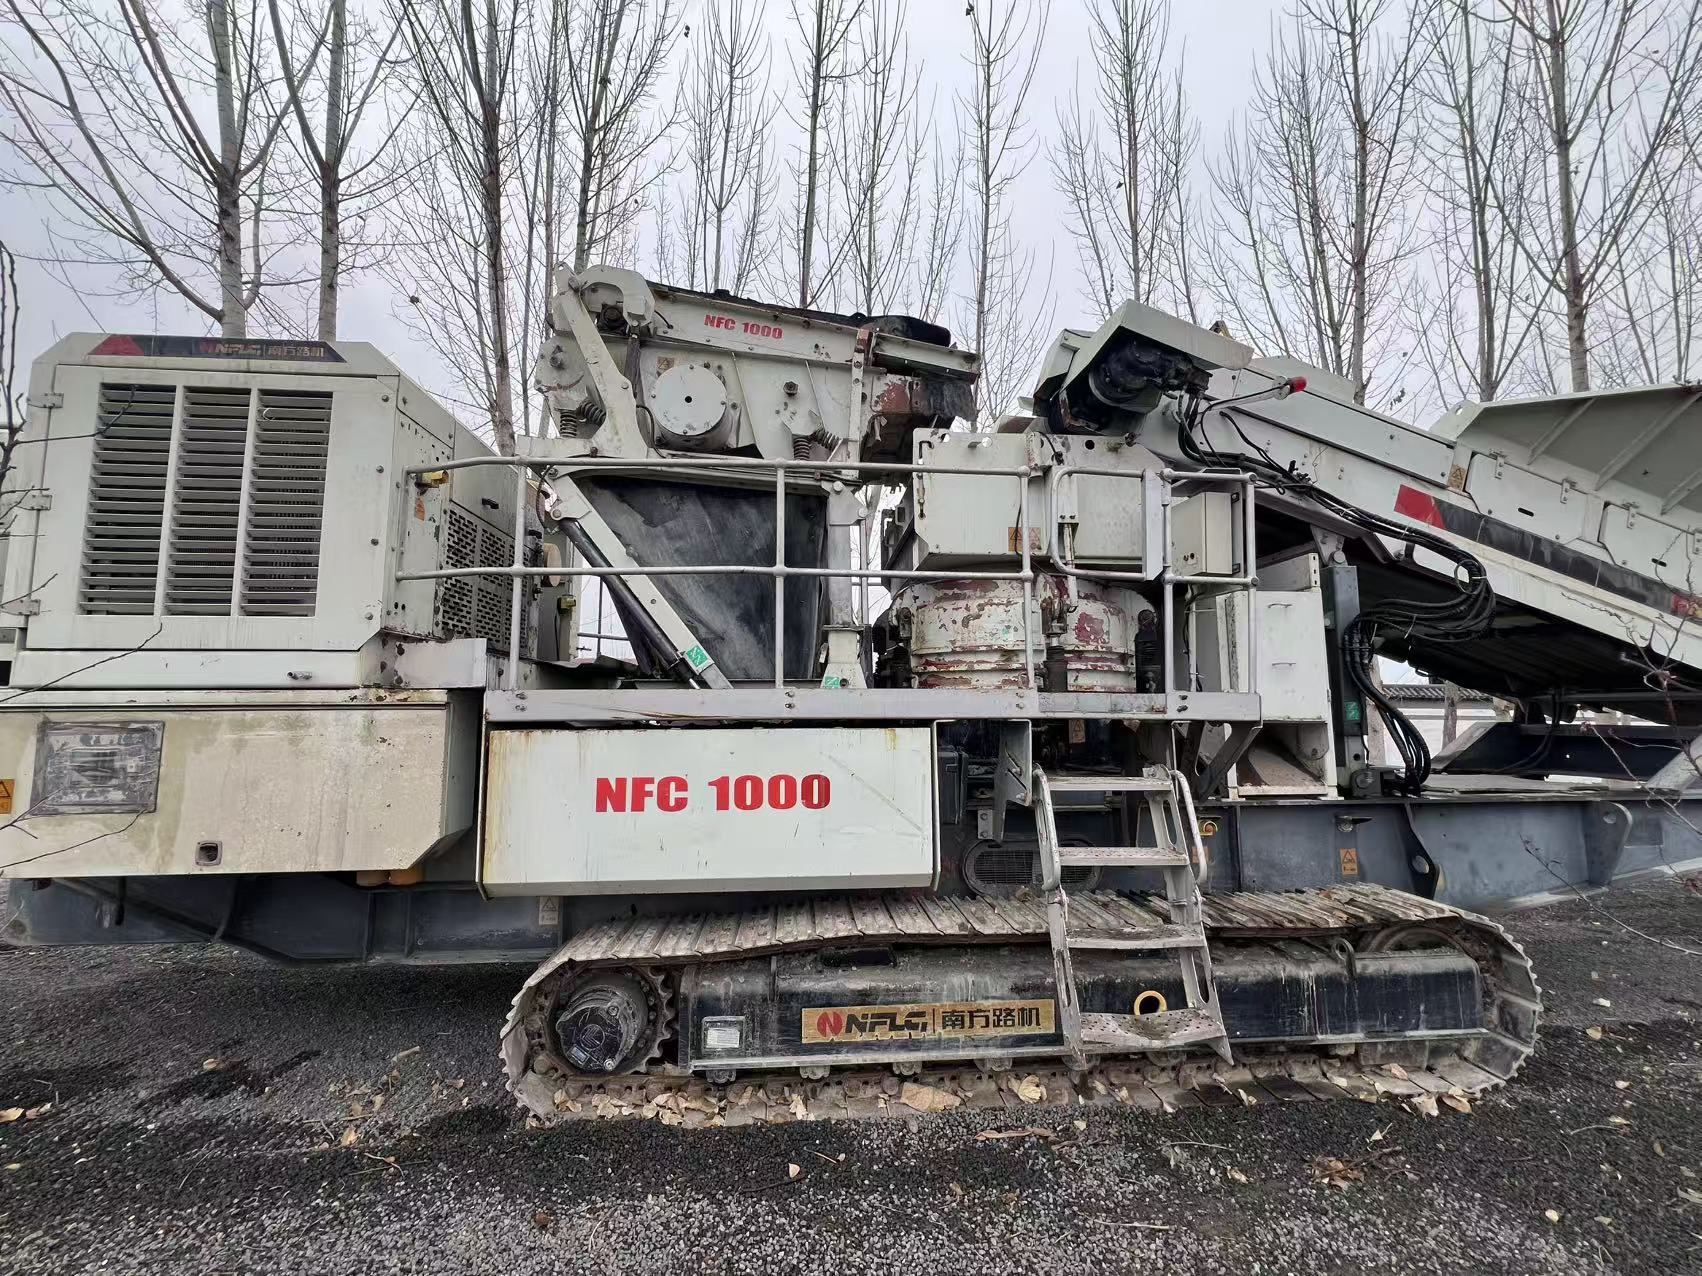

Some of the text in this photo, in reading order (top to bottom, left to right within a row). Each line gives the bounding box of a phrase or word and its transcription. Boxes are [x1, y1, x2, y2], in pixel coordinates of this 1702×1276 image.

[704, 315, 783, 339] NFC 1000
[595, 774, 831, 812] NFC 1000
[941, 1007, 1041, 1030] 南方路机
